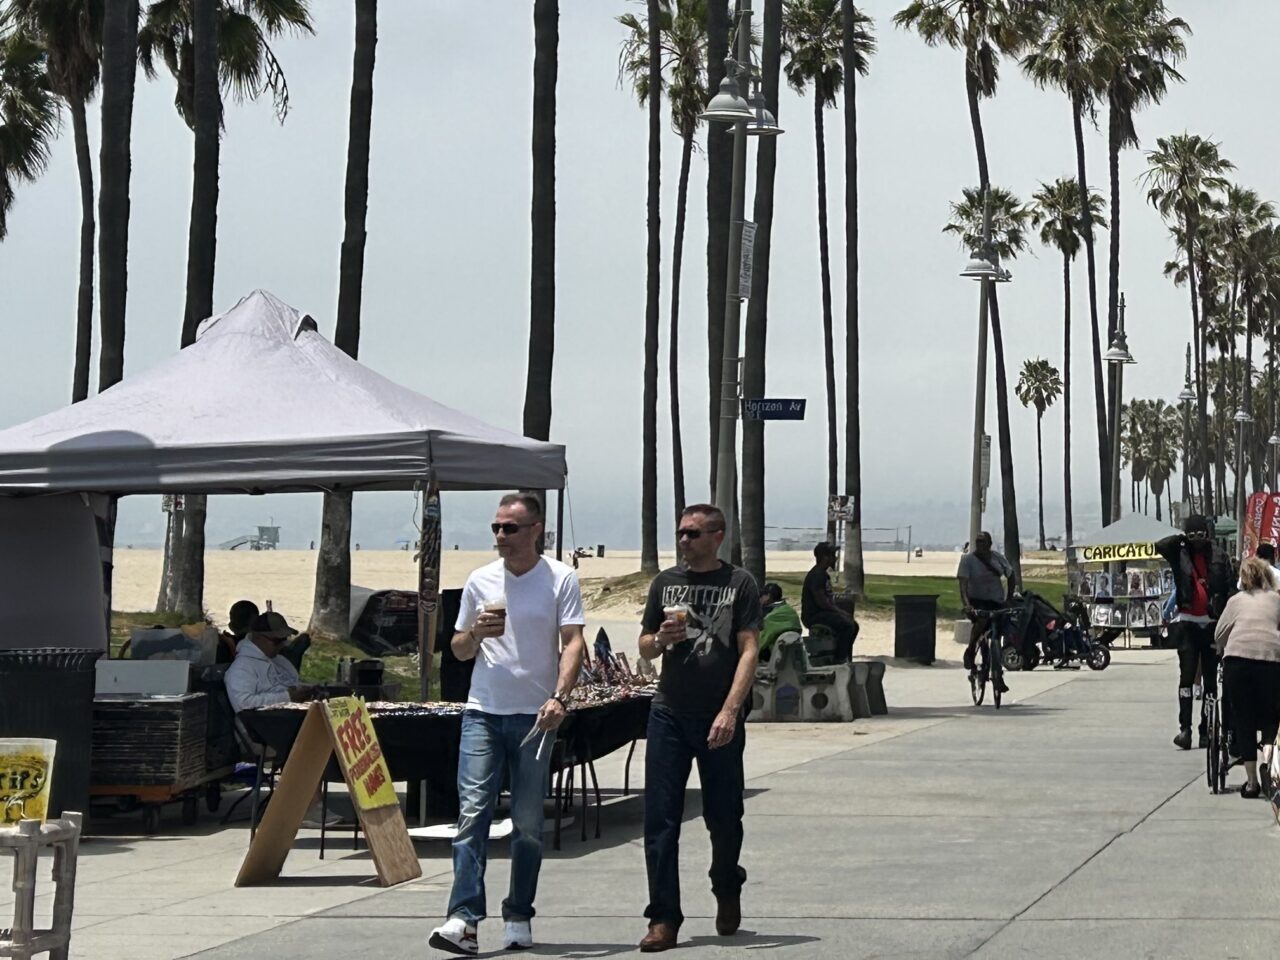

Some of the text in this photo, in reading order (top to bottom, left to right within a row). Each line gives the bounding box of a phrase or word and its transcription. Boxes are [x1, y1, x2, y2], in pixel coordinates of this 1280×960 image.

[745, 400, 782, 411] Horizon
[1083, 542, 1158, 560] CARICATU
[336, 706, 372, 765] FREE
